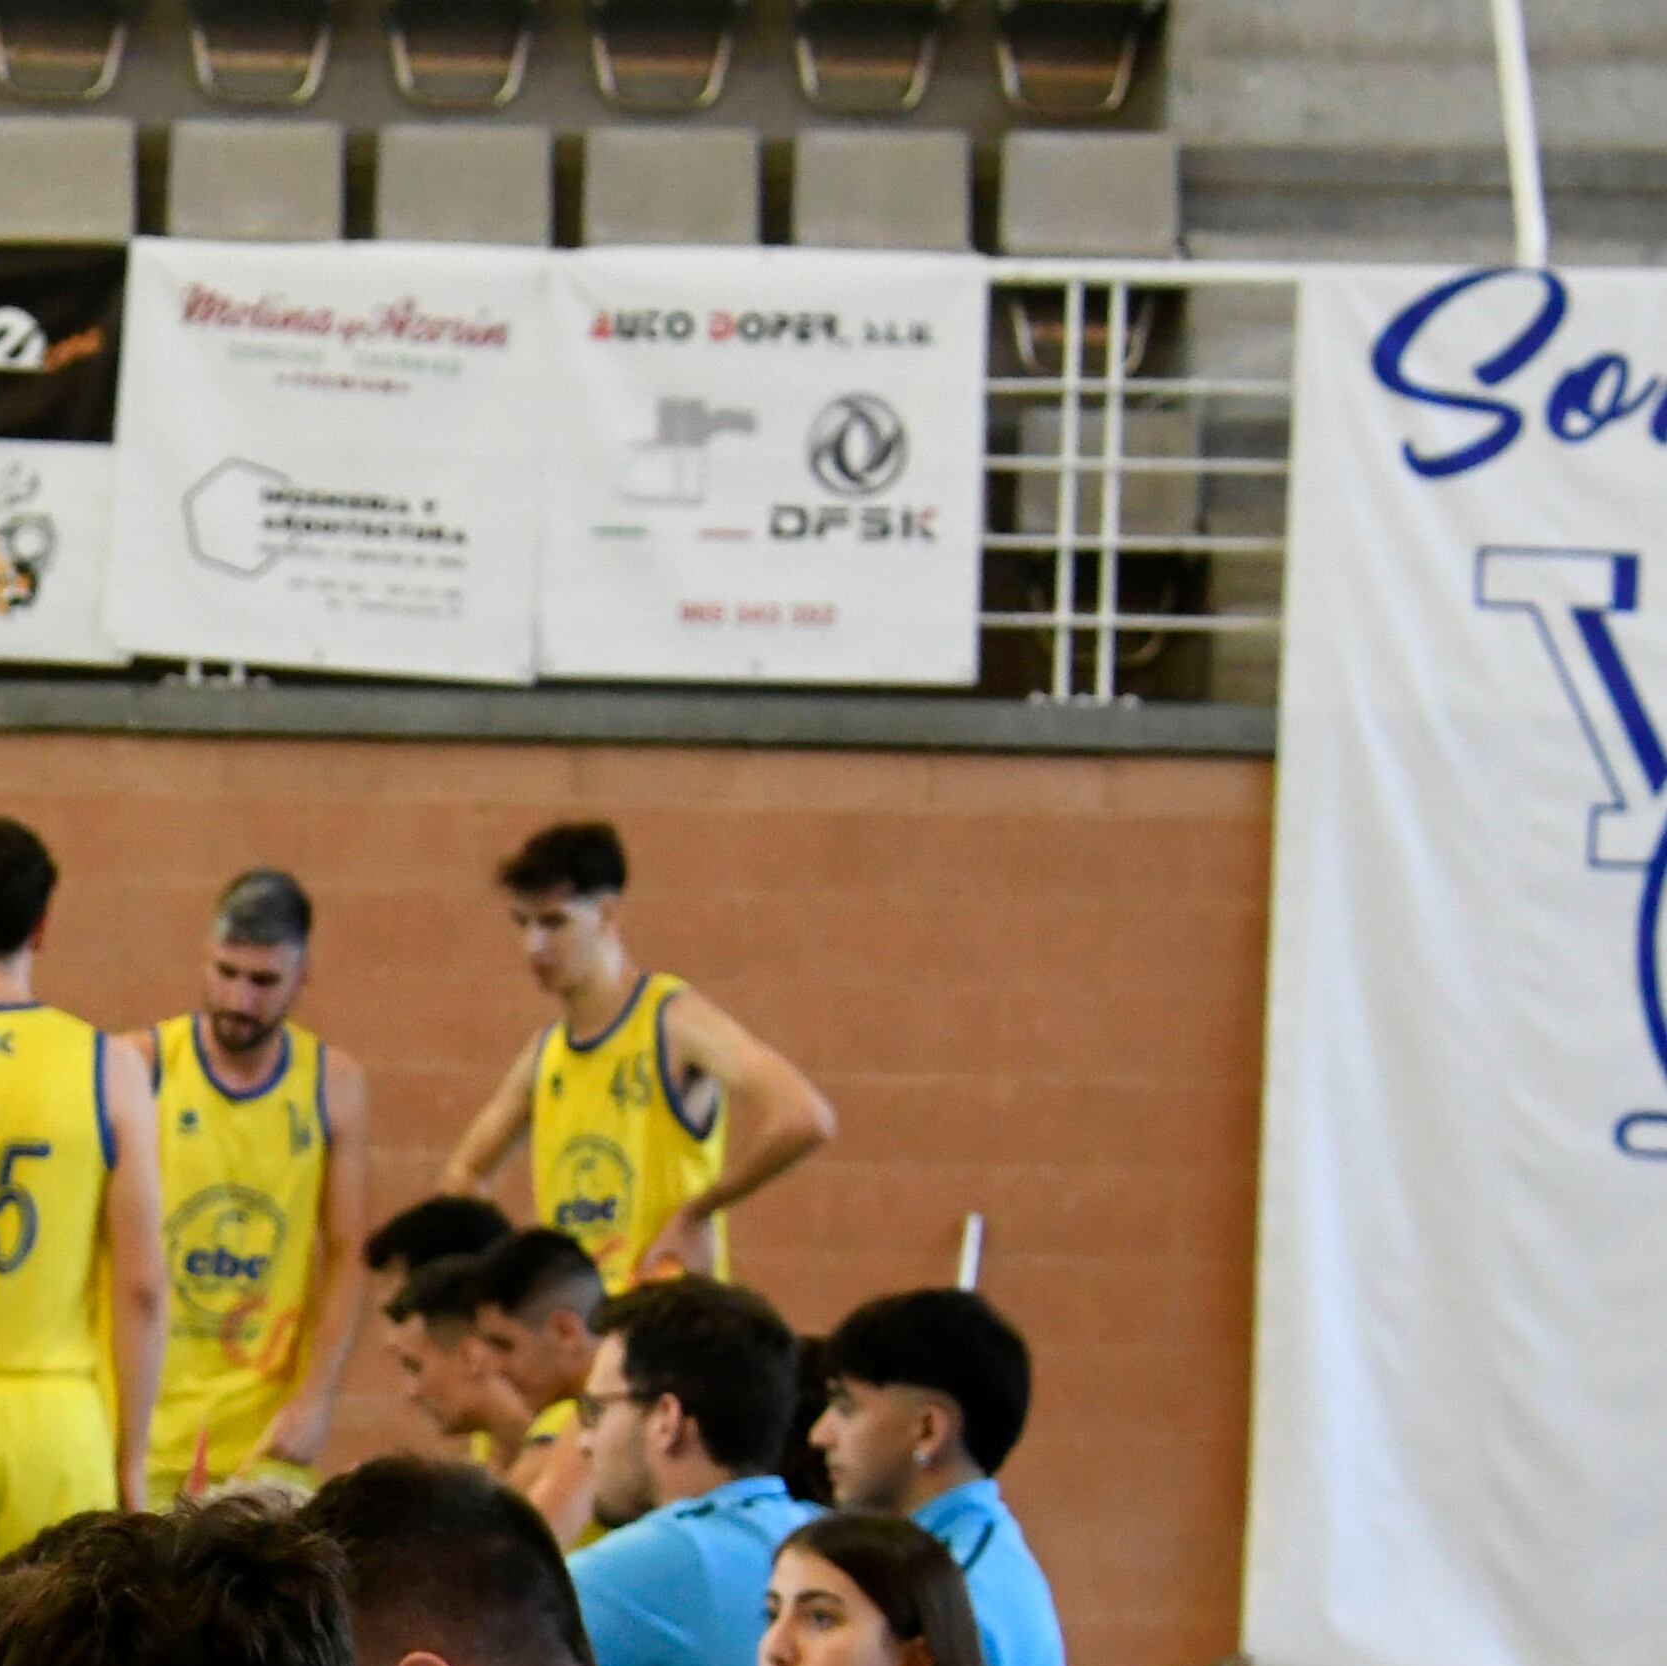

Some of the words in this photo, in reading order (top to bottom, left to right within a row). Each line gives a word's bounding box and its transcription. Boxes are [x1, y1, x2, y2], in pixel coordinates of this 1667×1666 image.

[590, 309, 696, 343] AUTO
[1372, 266, 1667, 478] So
[769, 505, 937, 542] DFSK
